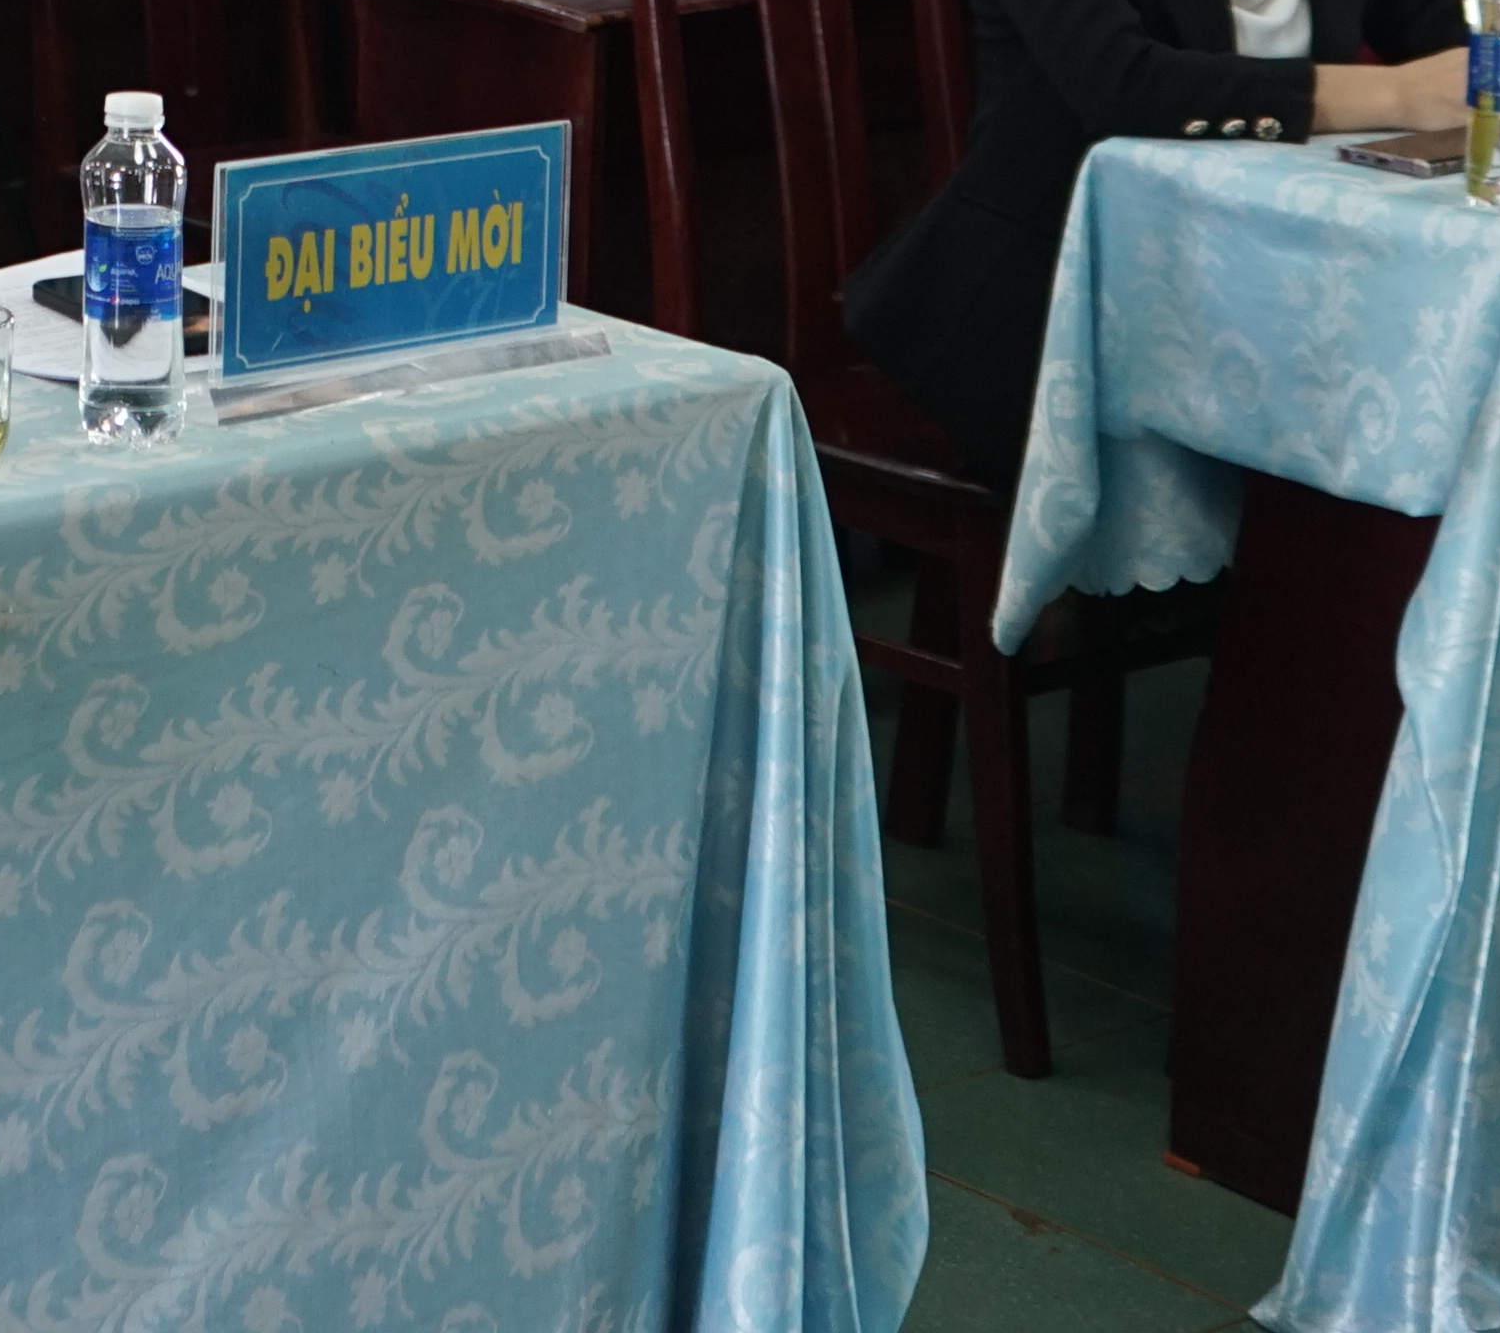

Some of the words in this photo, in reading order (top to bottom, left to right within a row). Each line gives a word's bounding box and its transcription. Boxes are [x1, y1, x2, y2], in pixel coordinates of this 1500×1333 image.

[265, 229, 336, 313] ĐẠI
[349, 192, 435, 290] BIỂU
[446, 188, 524, 275] MỜI
